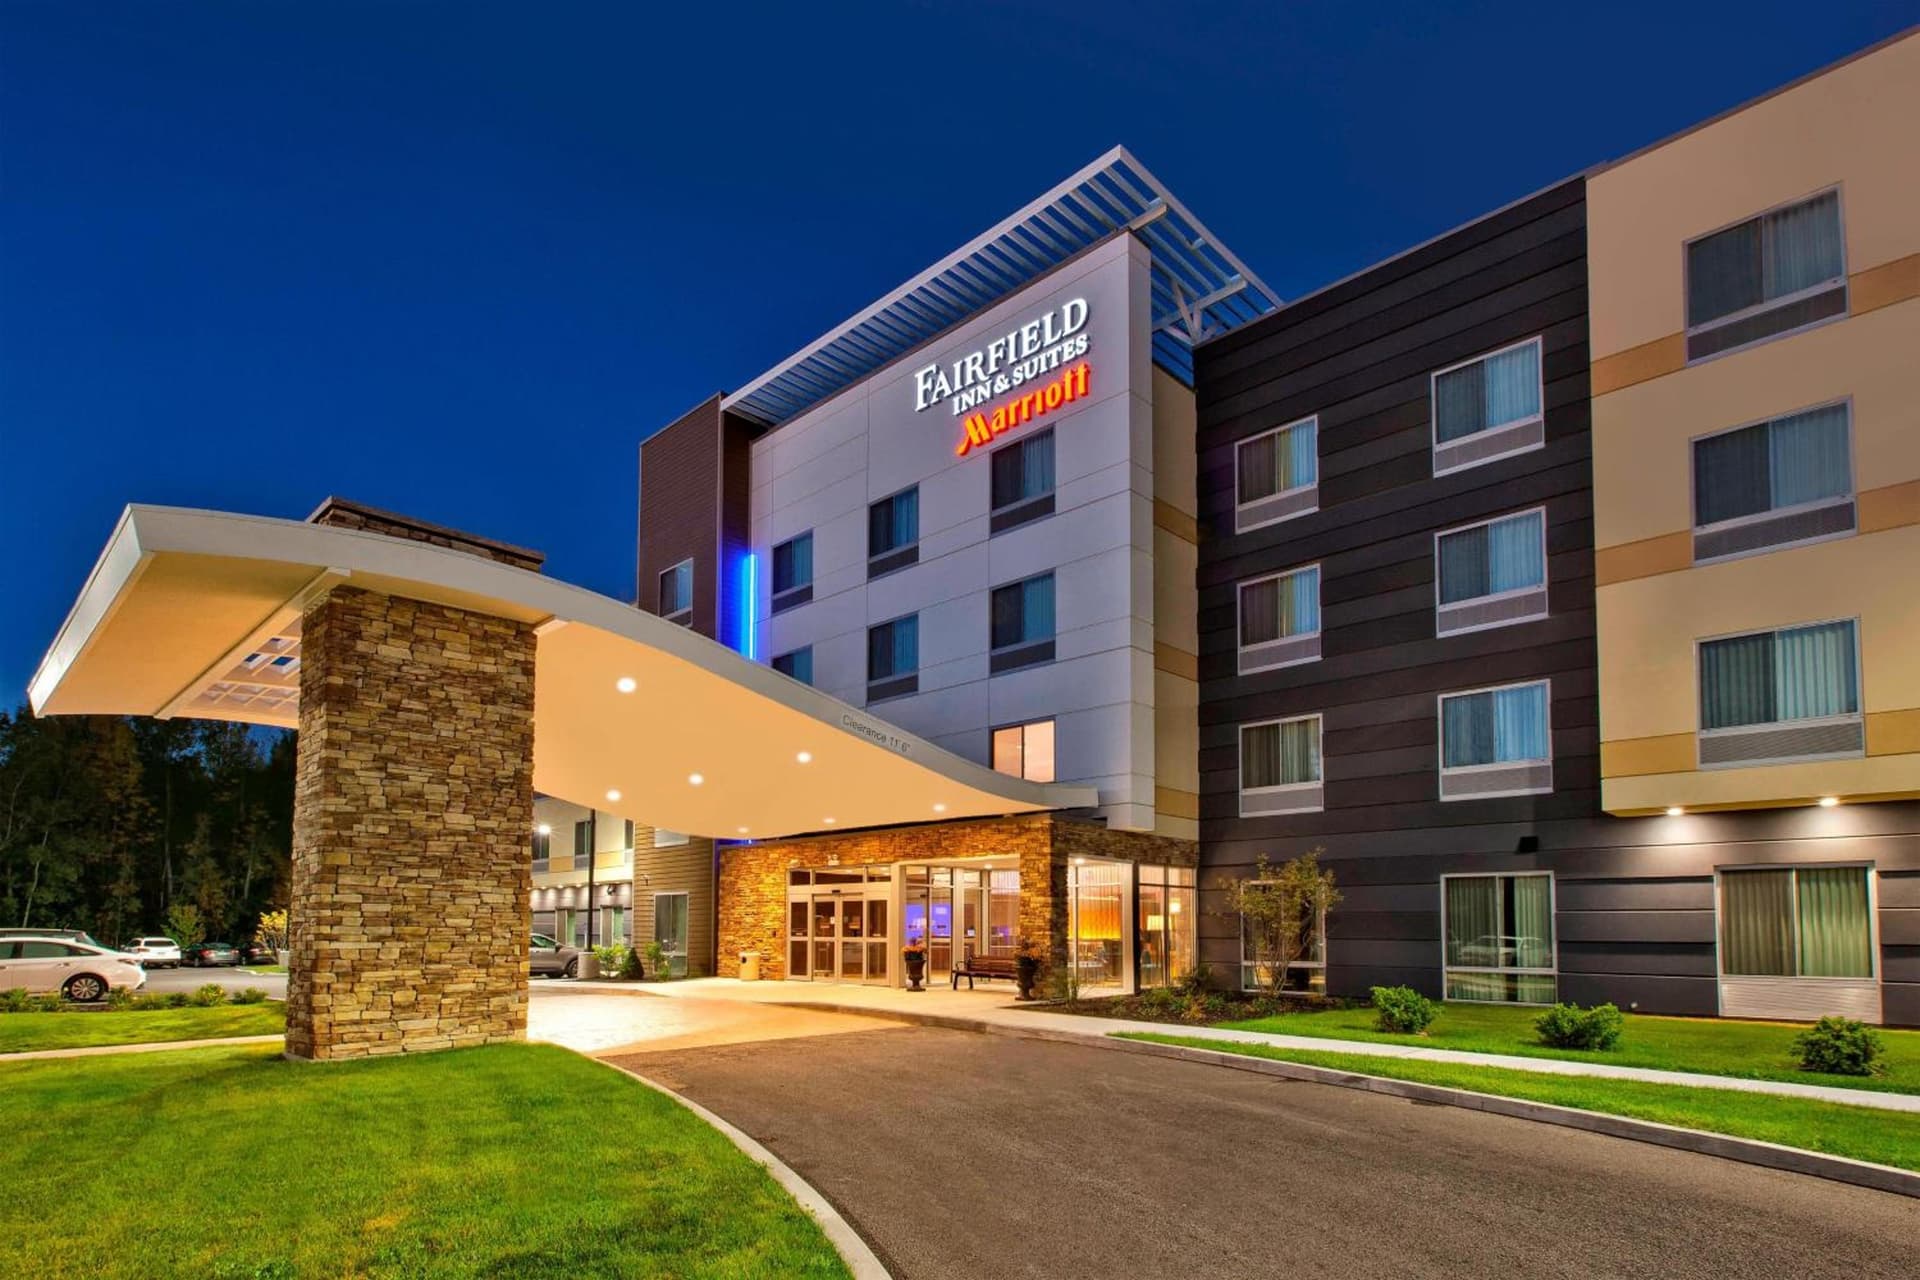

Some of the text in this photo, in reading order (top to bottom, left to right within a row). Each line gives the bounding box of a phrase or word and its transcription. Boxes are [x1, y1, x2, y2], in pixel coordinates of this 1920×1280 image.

[915, 298, 1088, 412] FAIRFIELD
[952, 333, 1088, 416] INN & SUITES
[956, 362, 1088, 455] Marriott
